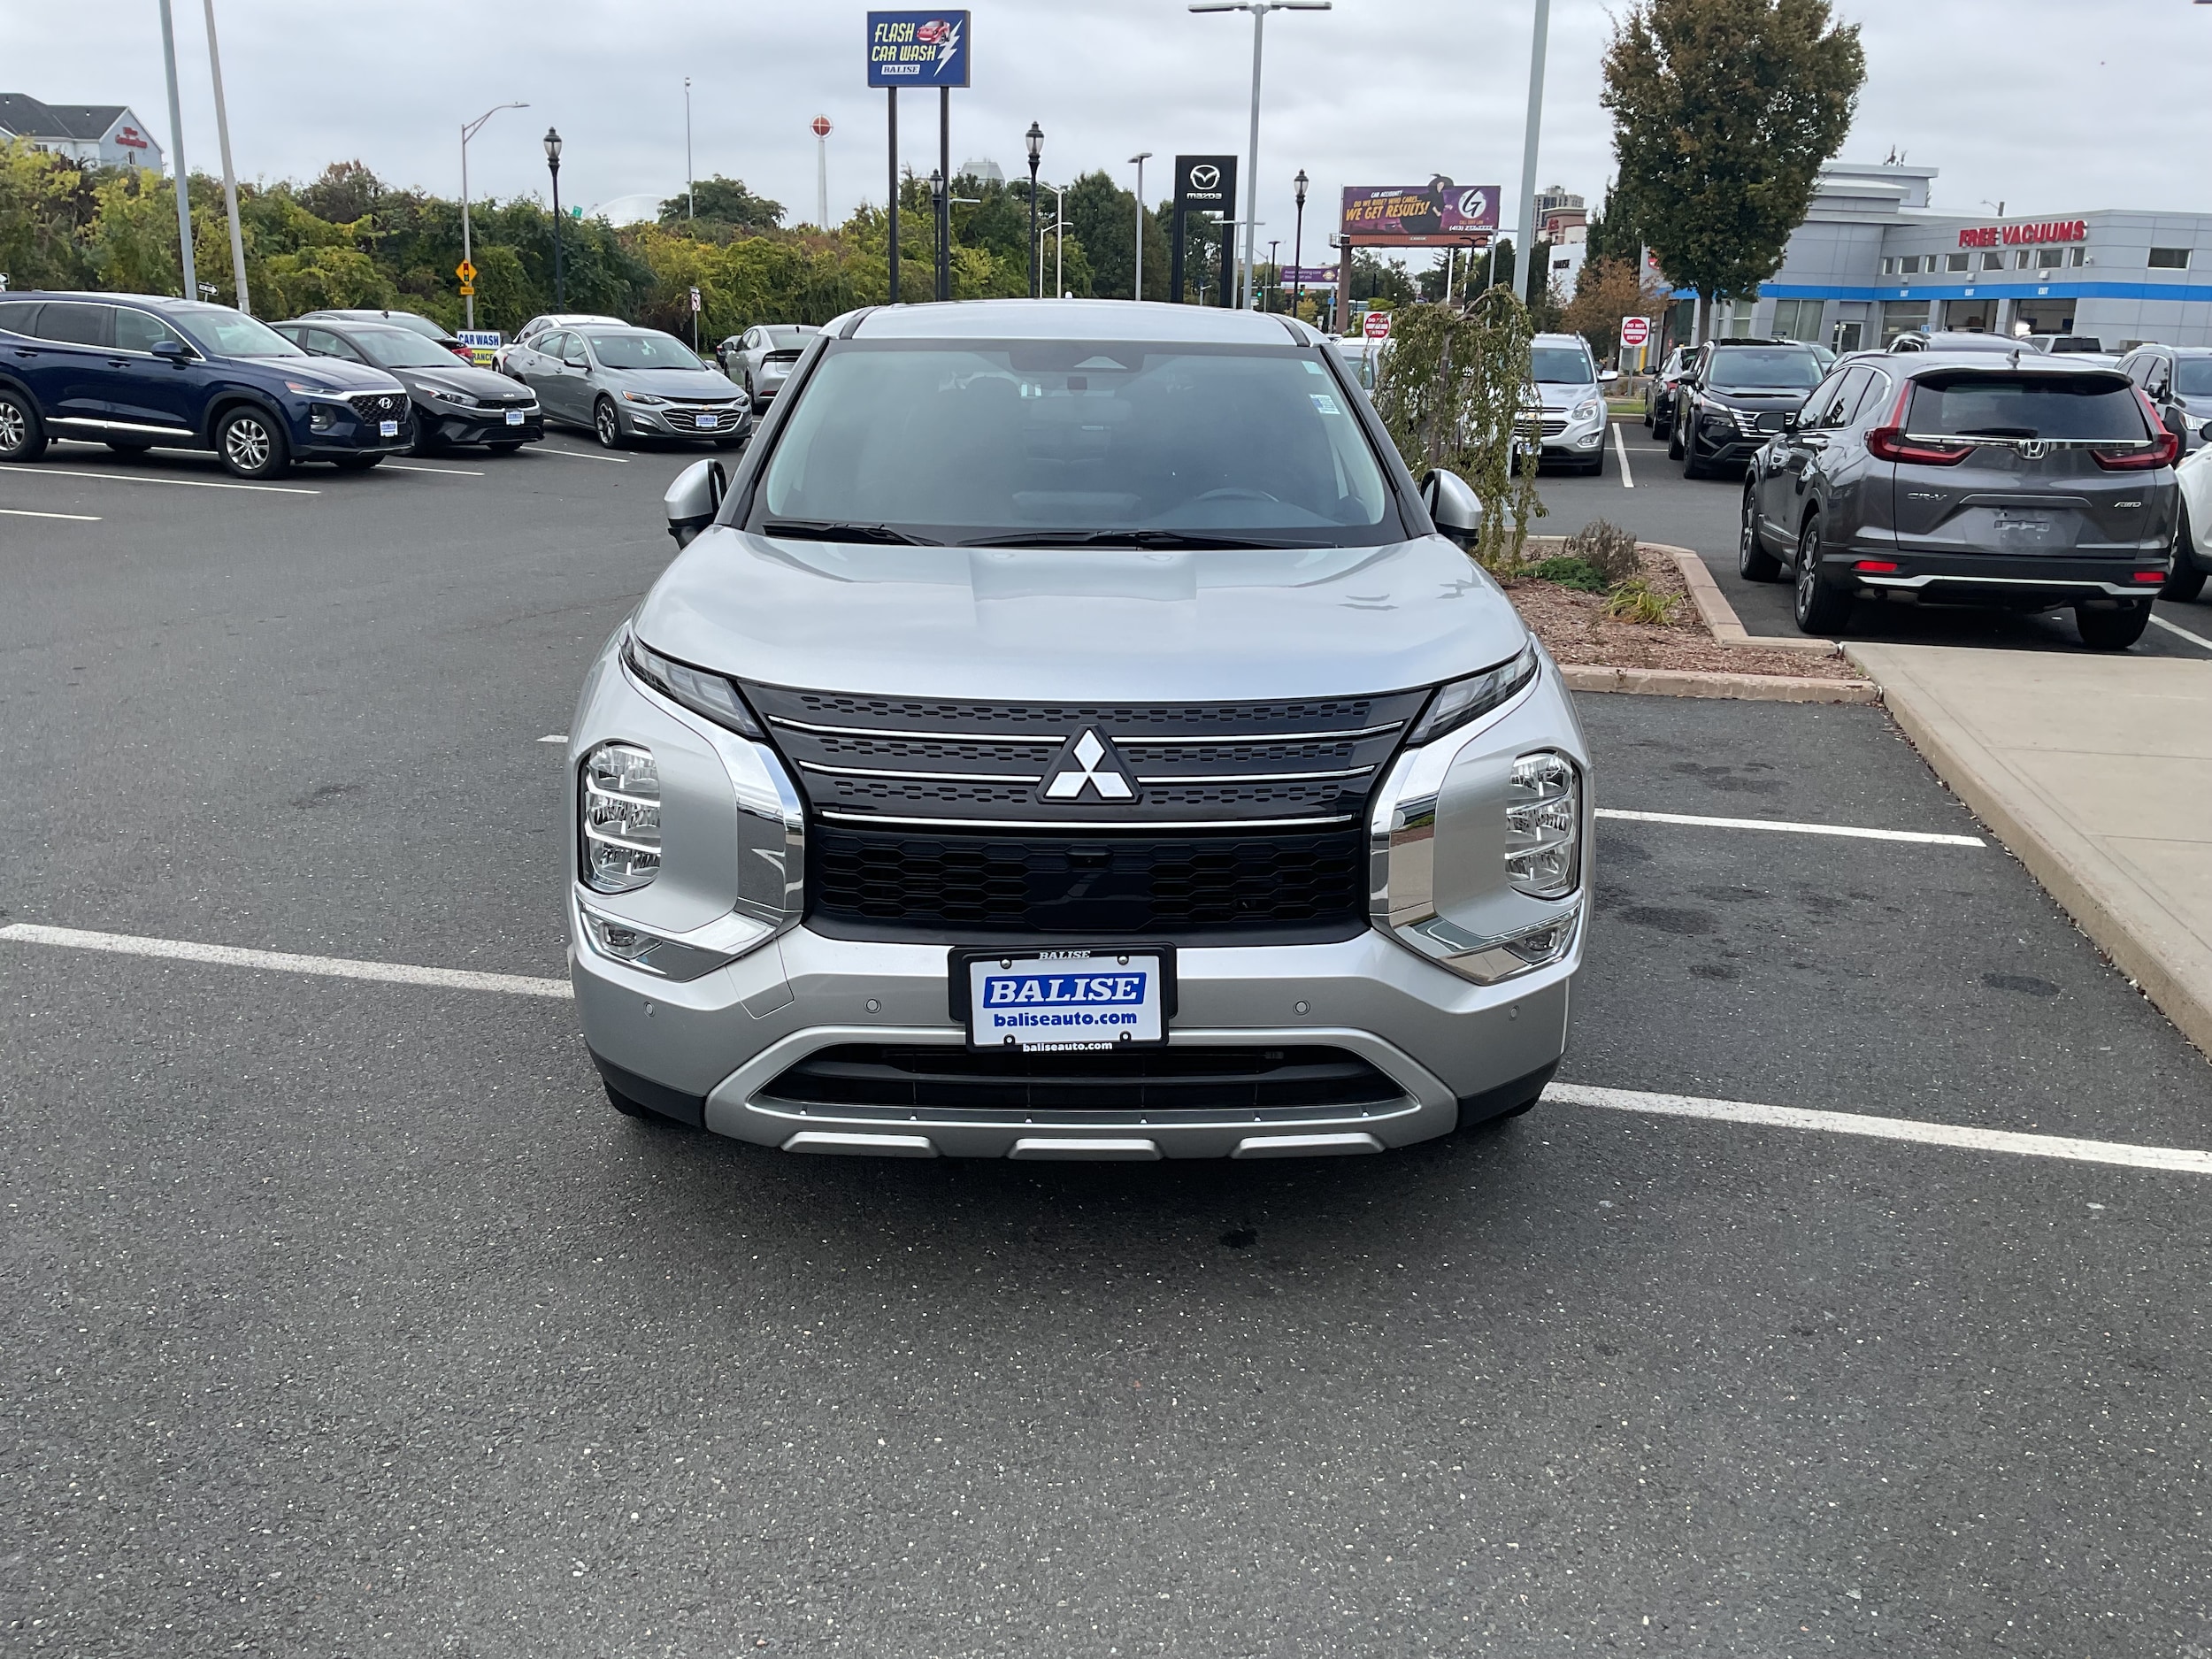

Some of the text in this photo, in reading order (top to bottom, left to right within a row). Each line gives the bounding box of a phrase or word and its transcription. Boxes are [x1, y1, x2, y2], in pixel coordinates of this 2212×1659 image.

[874, 22, 915, 42] FLASH
[872, 45, 936, 62] CAR WASH
[1346, 201, 1431, 221] WE GET RESULTS!
[1959, 220, 2088, 248] FREE VACUUMS
[459, 334, 499, 346] CAR WASH
[1039, 950, 1091, 960] BALISE
[989, 977, 1141, 1003] BALISE
[994, 1011, 1137, 1027] baliseauto.com
[1022, 1042, 1113, 1053] baliseauto.com
